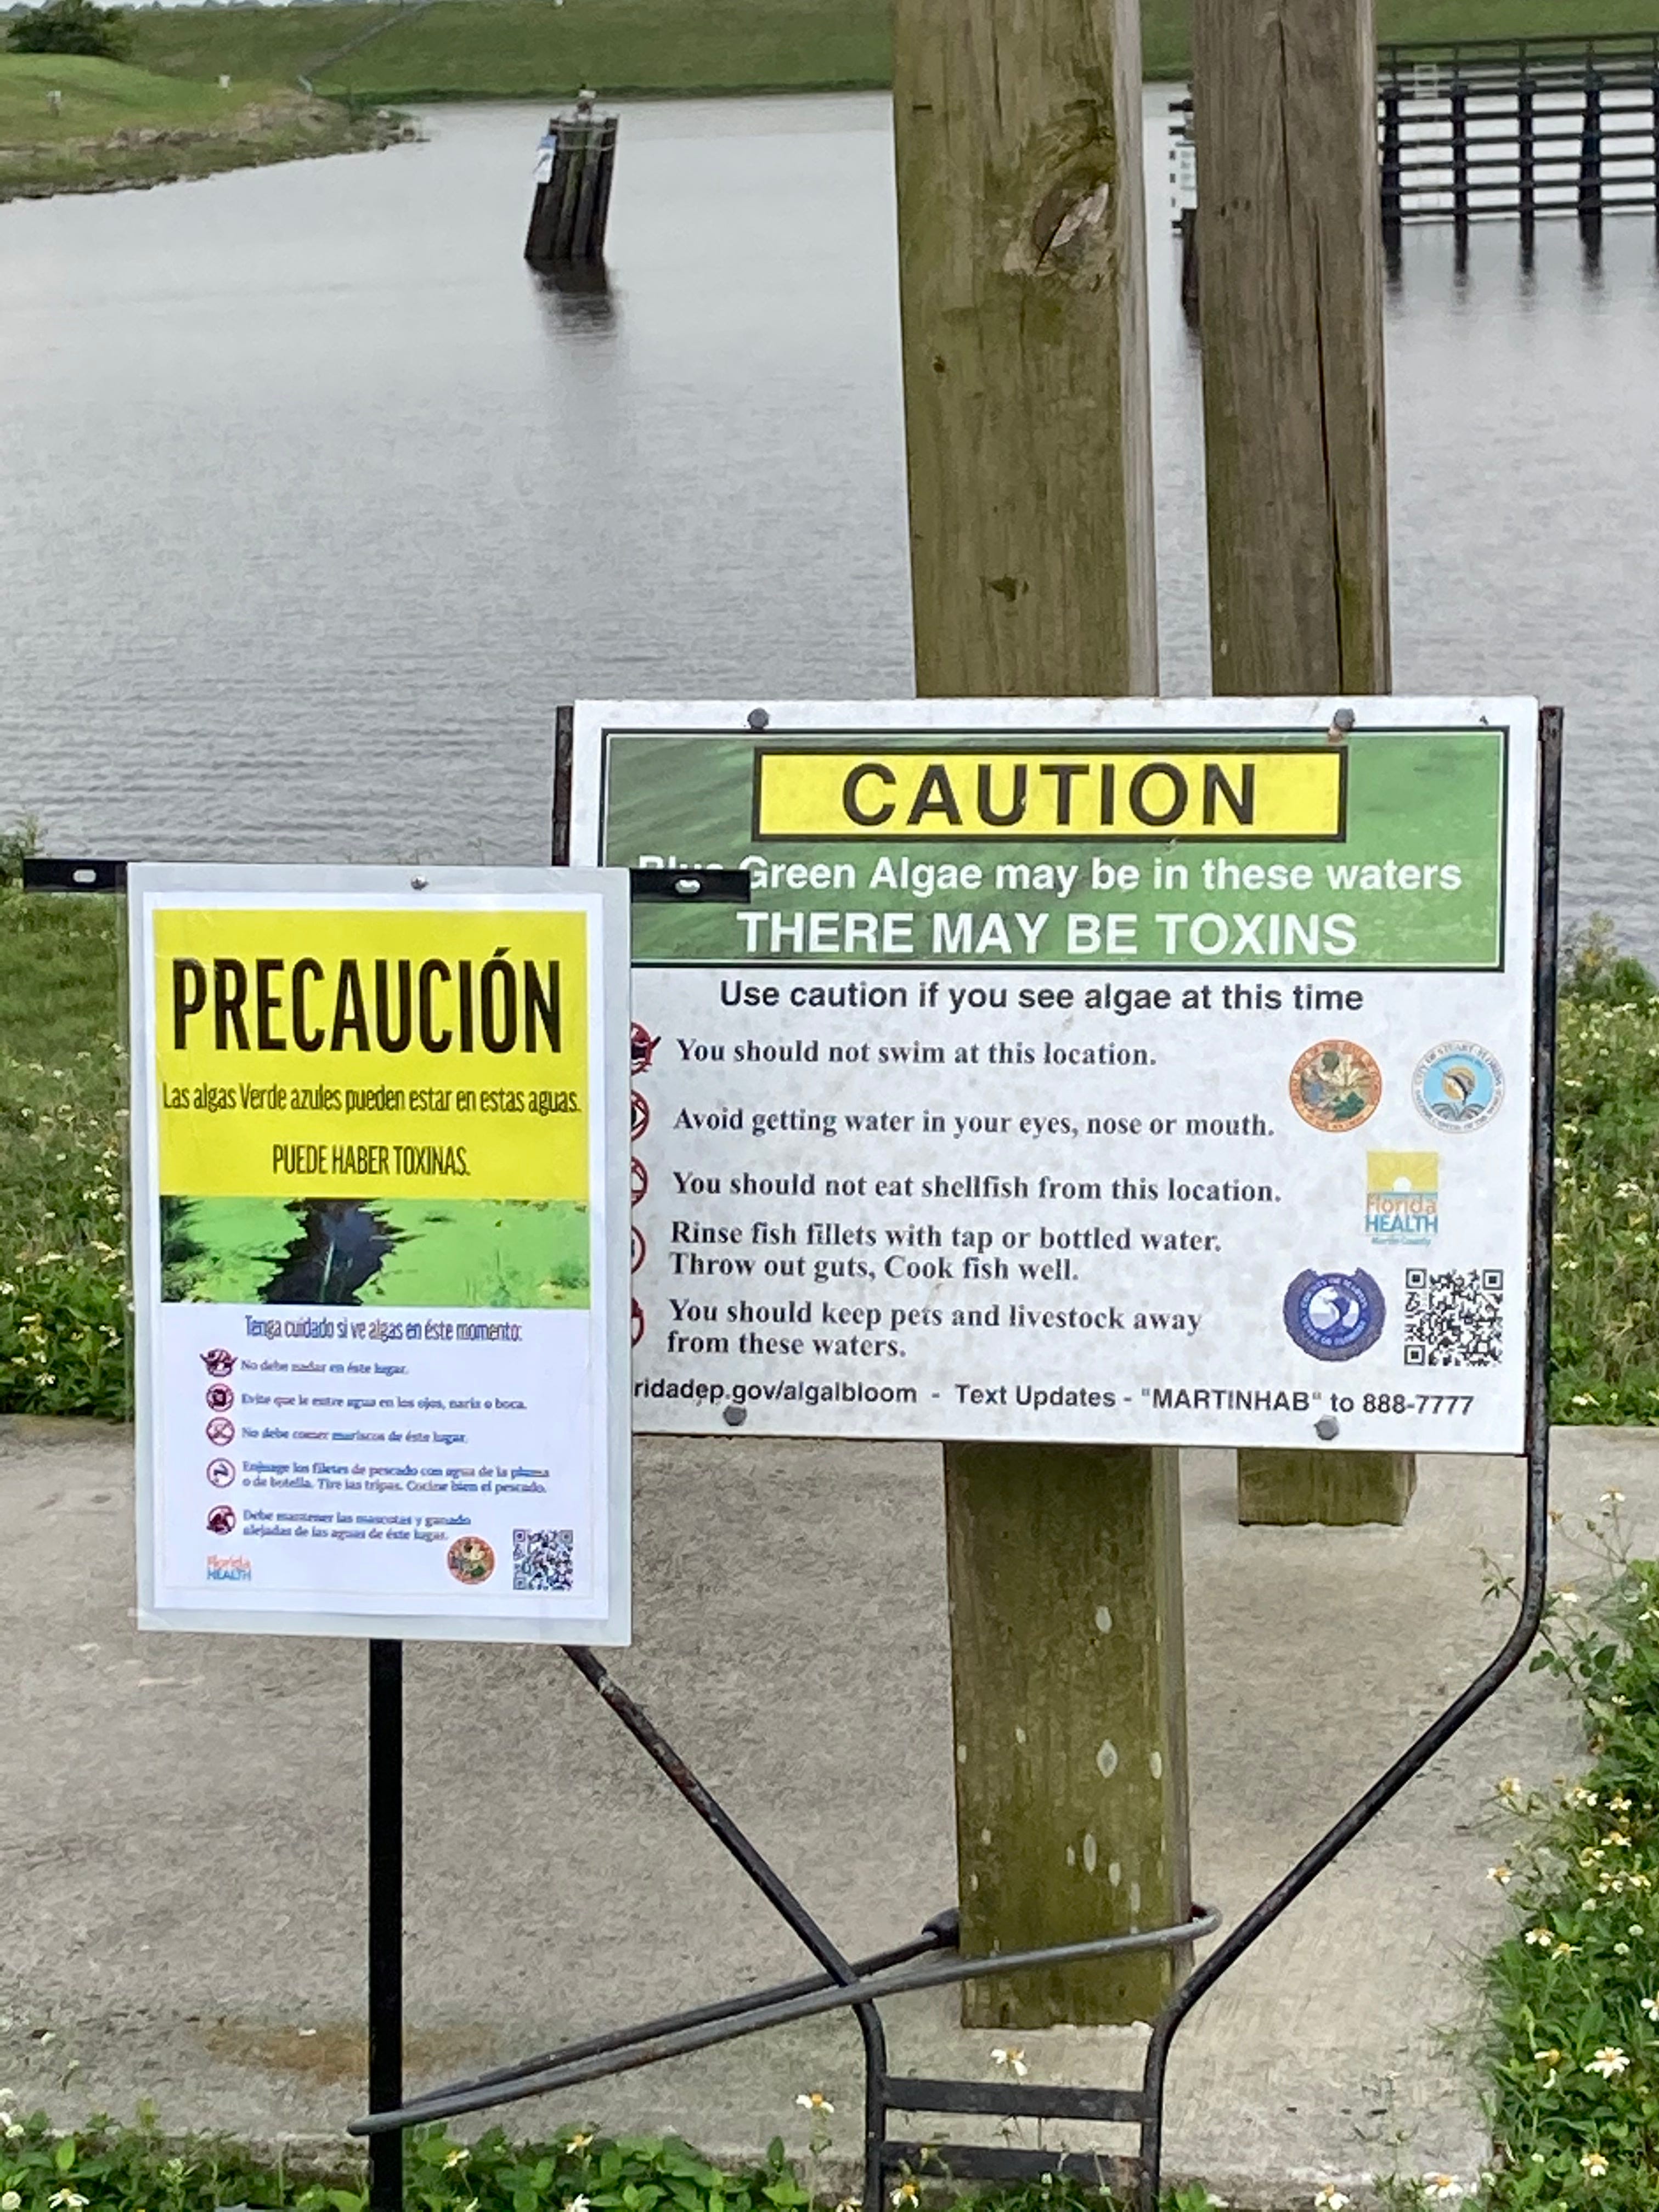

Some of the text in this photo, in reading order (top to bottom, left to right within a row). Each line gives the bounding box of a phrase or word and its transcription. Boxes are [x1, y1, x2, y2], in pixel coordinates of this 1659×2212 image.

[842, 762, 1255, 827] CAUTION
[739, 856, 855, 889] Green
[870, 857, 982, 898] Algae
[996, 864, 1079, 898] may
[1092, 857, 1139, 890] be
[1154, 857, 1188, 889] in
[1201, 857, 1313, 890] these
[1326, 859, 1462, 890] waters
[736, 912, 1357, 956] THERE MAY BE TOXINS
[173, 947, 561, 1054] PRECAUCIÓN
[720, 980, 1363, 1016] Use caution if you see algae at this time
[676, 1038, 1156, 1065] You should not swim at this location.
[162, 1082, 582, 1117] Las algas Verde azules pueden estar en estas aguas.
[673, 1107, 1274, 1139] Avoid getting water in your eyes, nose or mouth.
[273, 1144, 471, 1176] PUEDE HABER TOXINAS.
[673, 1171, 1281, 1202] You should not eat shellfish from this location.
[1367, 1194, 1437, 1214] Florida
[670, 1221, 1221, 1254] Rinse fish fillets with tap or bottled water.
[1365, 1214, 1438, 1233] HEALTH
[668, 1251, 1077, 1282] Throw out guts, Cook fish well.
[668, 1298, 1199, 1336] You should keep pets and livestock away
[667, 1330, 905, 1357] from these waters.
[955, 1384, 1007, 1405] Text
[1016, 1385, 1116, 1410] Updates
[1330, 1393, 1354, 1413] to
[1363, 1393, 1474, 1415] 888-7777
